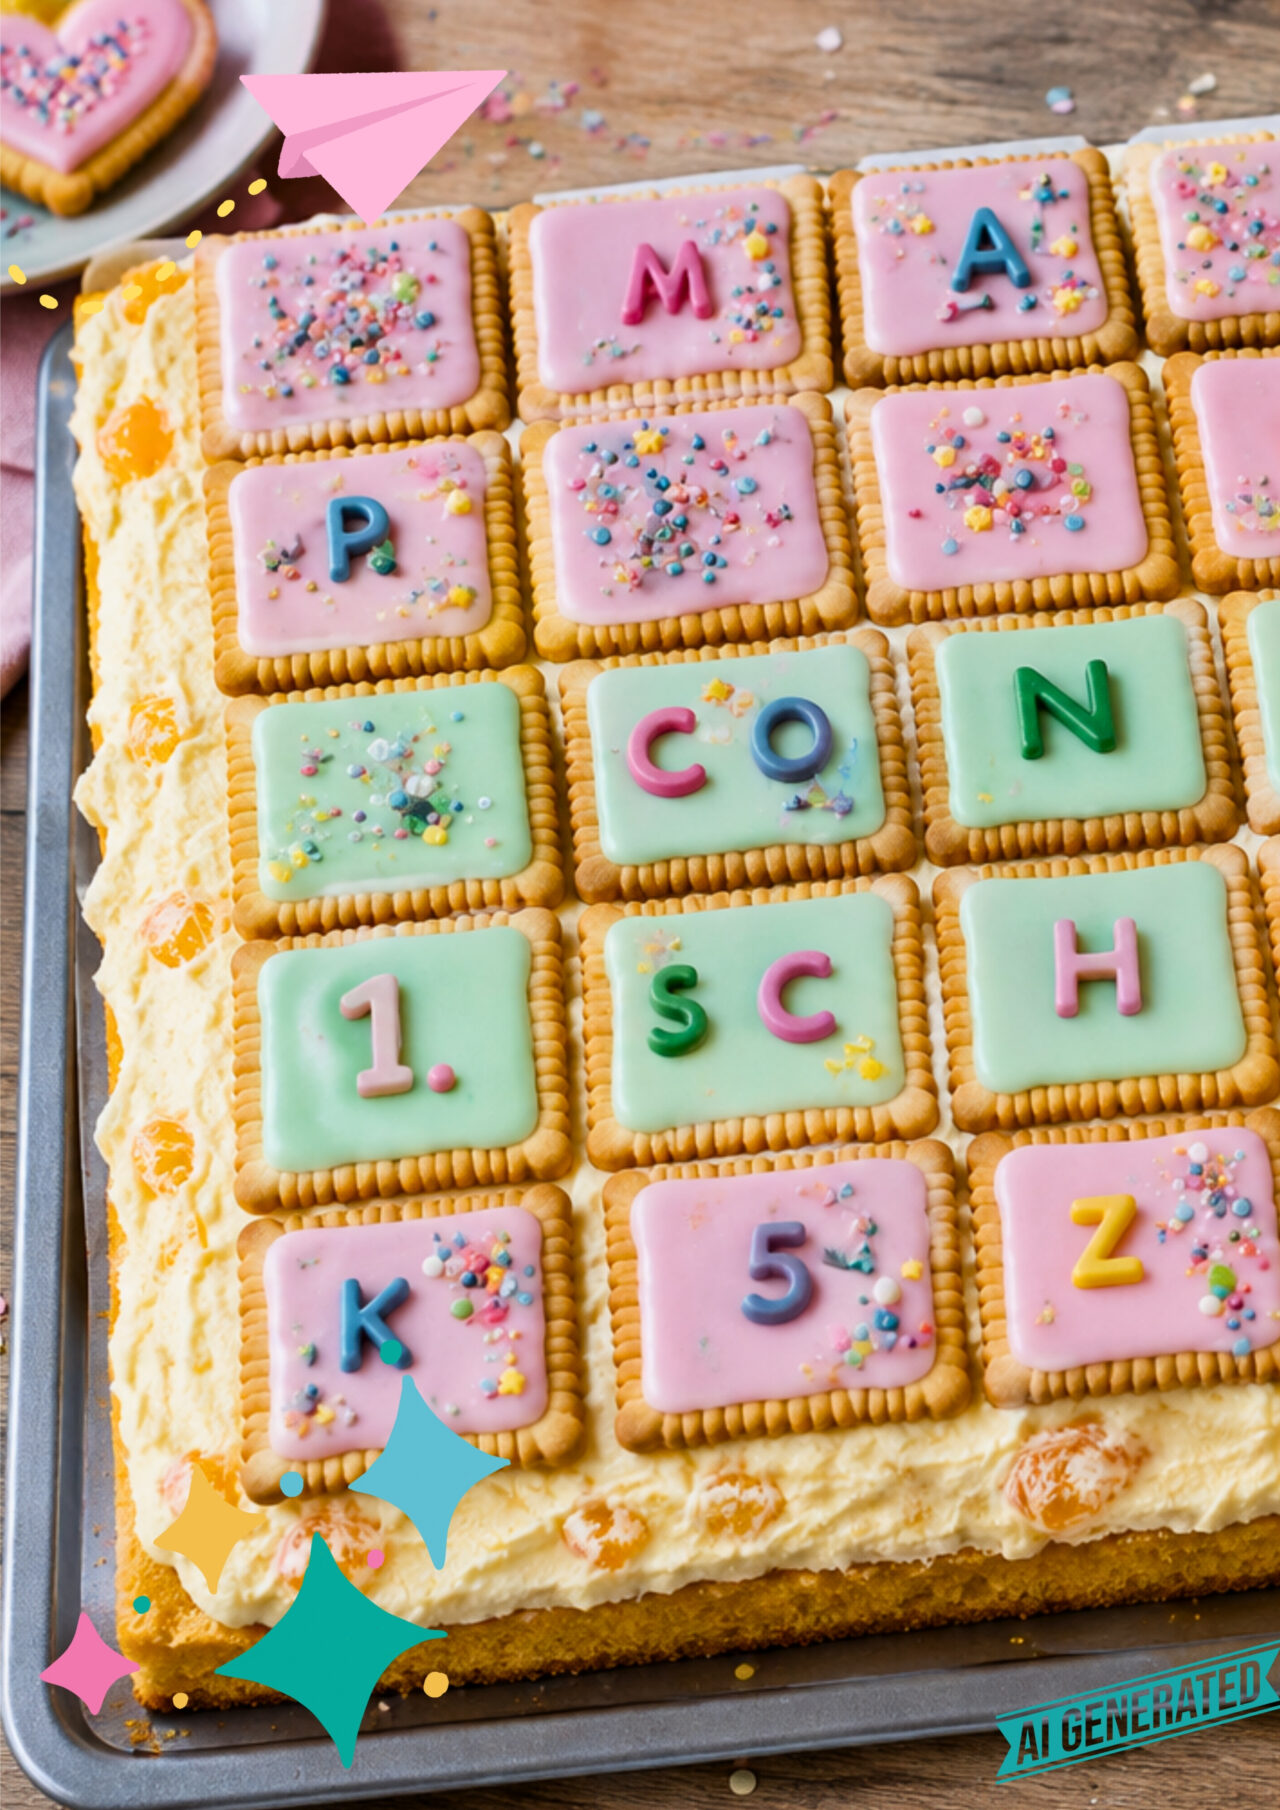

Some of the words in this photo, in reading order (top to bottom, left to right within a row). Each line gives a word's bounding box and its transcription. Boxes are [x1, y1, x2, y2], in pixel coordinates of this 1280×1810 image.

[624, 239, 715, 326] M
[951, 207, 1032, 292] A
[325, 496, 390, 584] P
[340, 1276, 412, 1373] K
[741, 1220, 815, 1325] 5
[1070, 1194, 1144, 1290] Z
